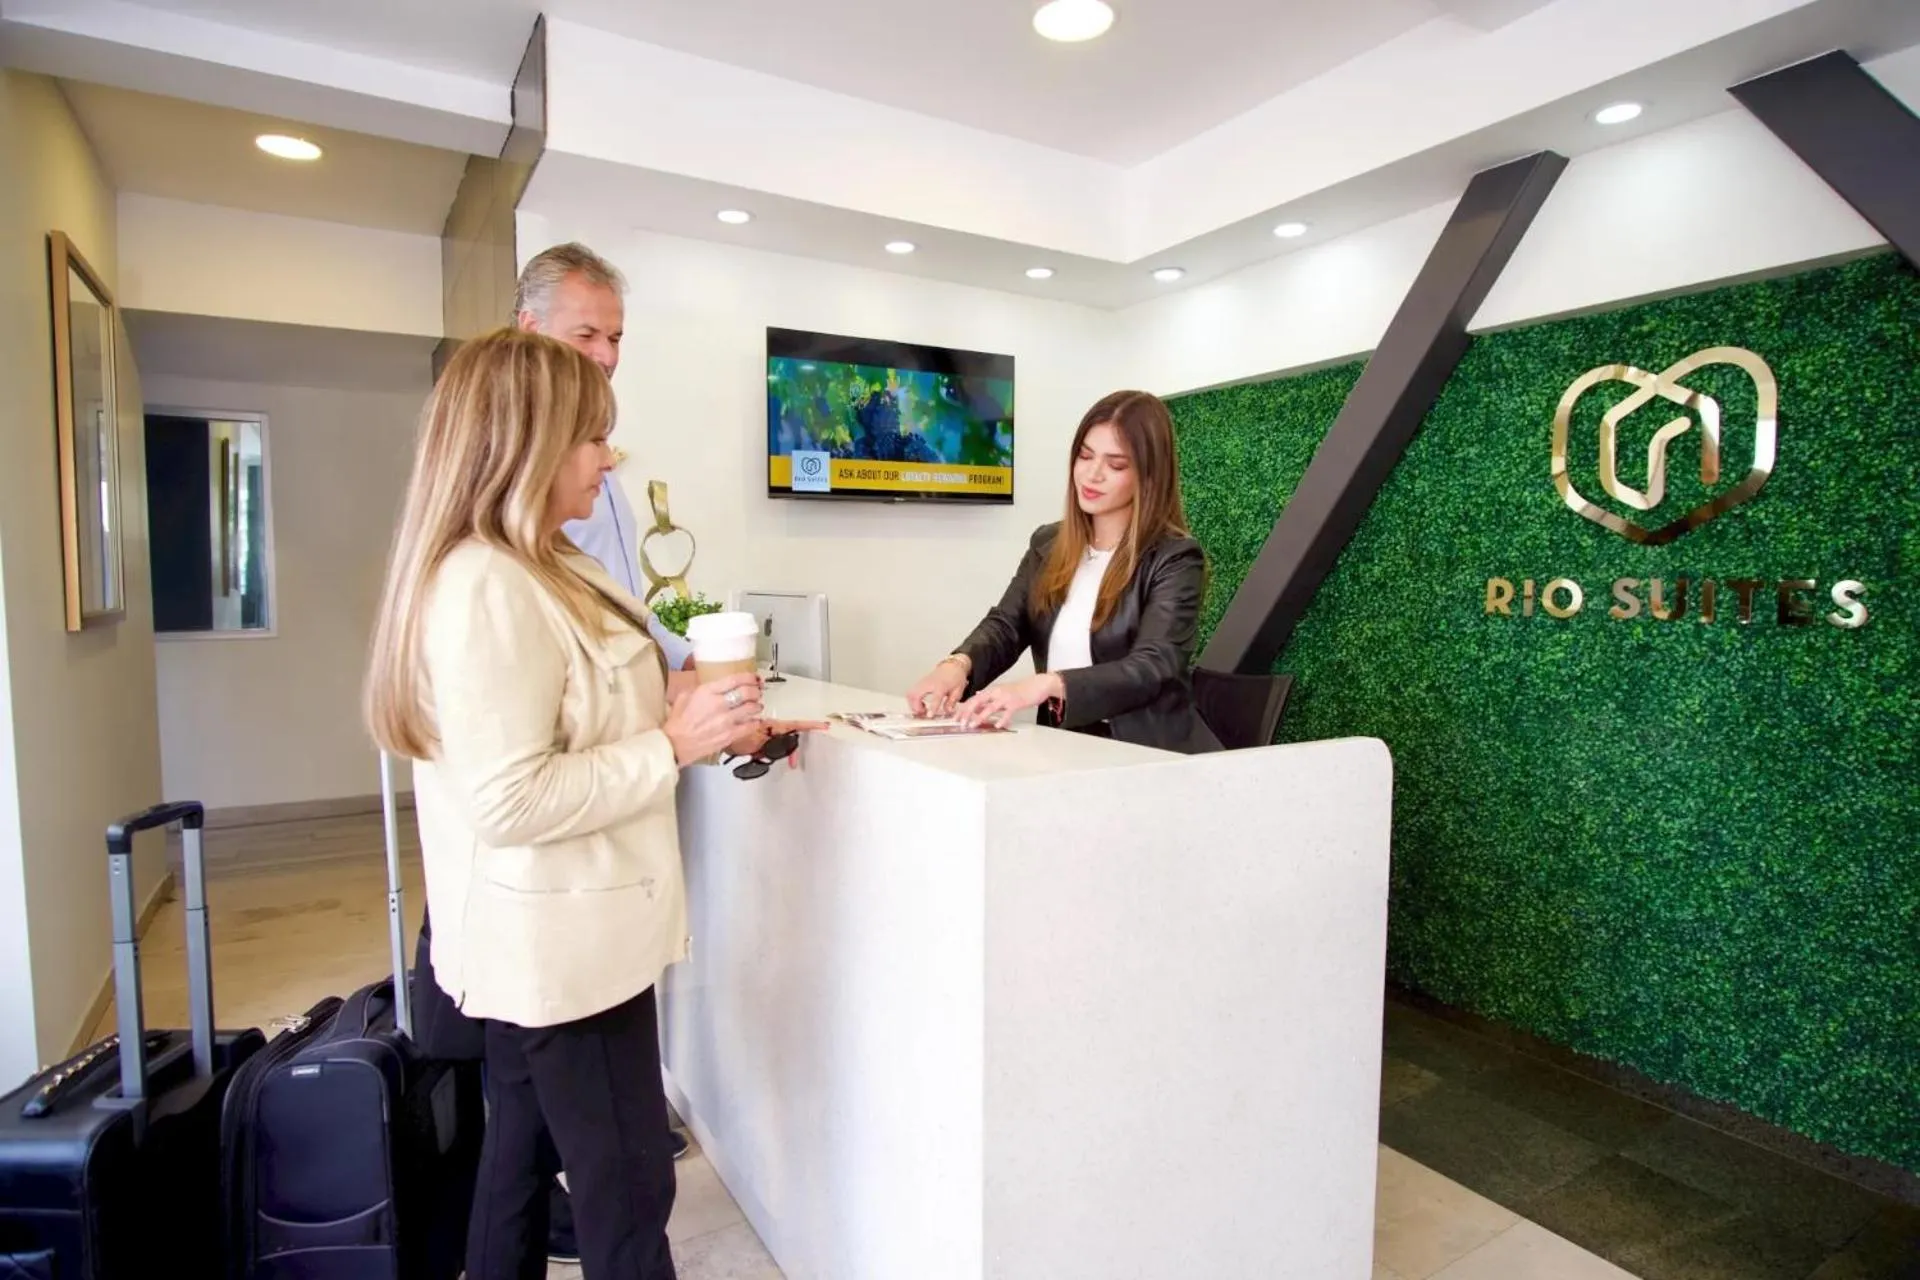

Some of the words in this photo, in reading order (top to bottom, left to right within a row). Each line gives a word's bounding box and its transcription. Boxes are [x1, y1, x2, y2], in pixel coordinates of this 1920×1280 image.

[838, 468, 855, 480] ASK
[856, 469, 882, 481] ABOUT
[883, 470, 899, 481] OUR
[1483, 576, 1584, 618] RIO
[1608, 577, 1869, 629] SUITES
